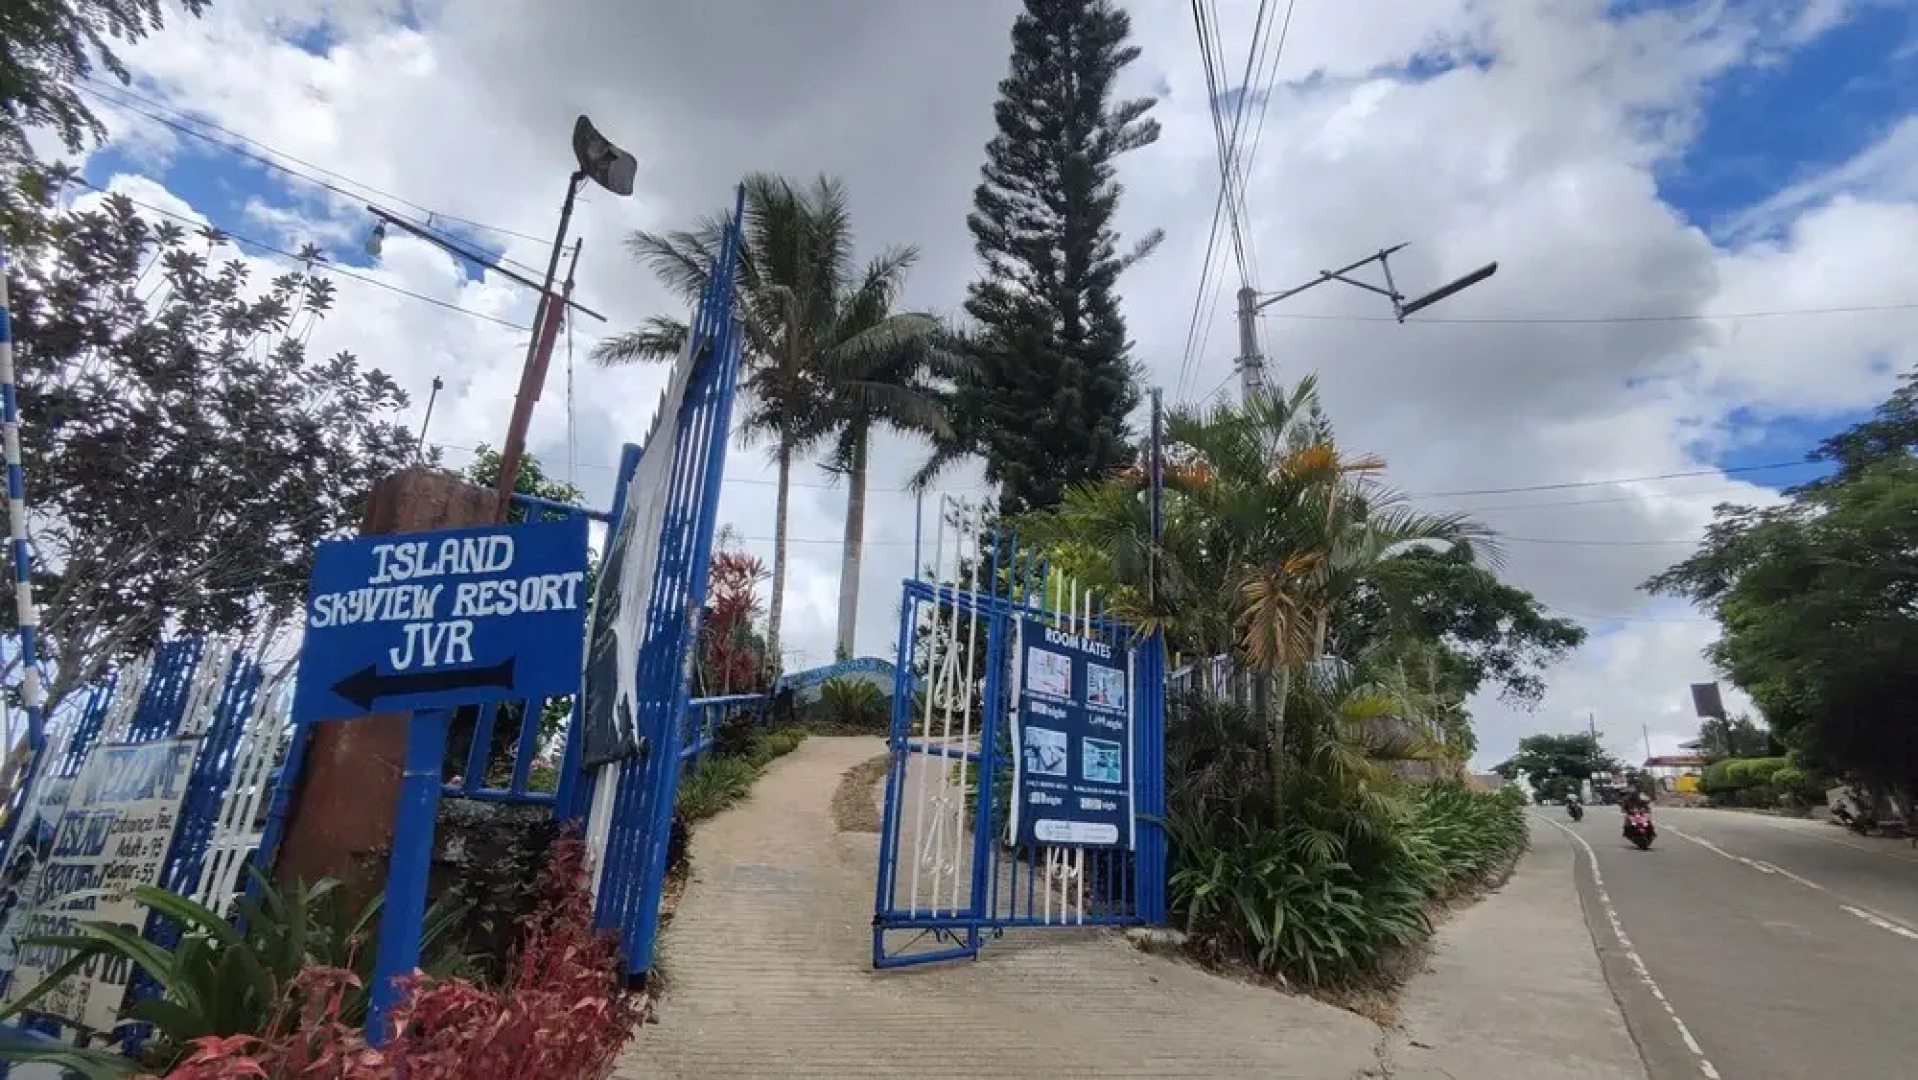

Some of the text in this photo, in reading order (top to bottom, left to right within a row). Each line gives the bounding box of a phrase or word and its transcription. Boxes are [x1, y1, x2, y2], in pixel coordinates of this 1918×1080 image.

[369, 535, 514, 584] ISLAND
[452, 572, 583, 616] RESORT
[389, 619, 474, 670] JVR
[1045, 627, 1111, 659] ROOM RATES
